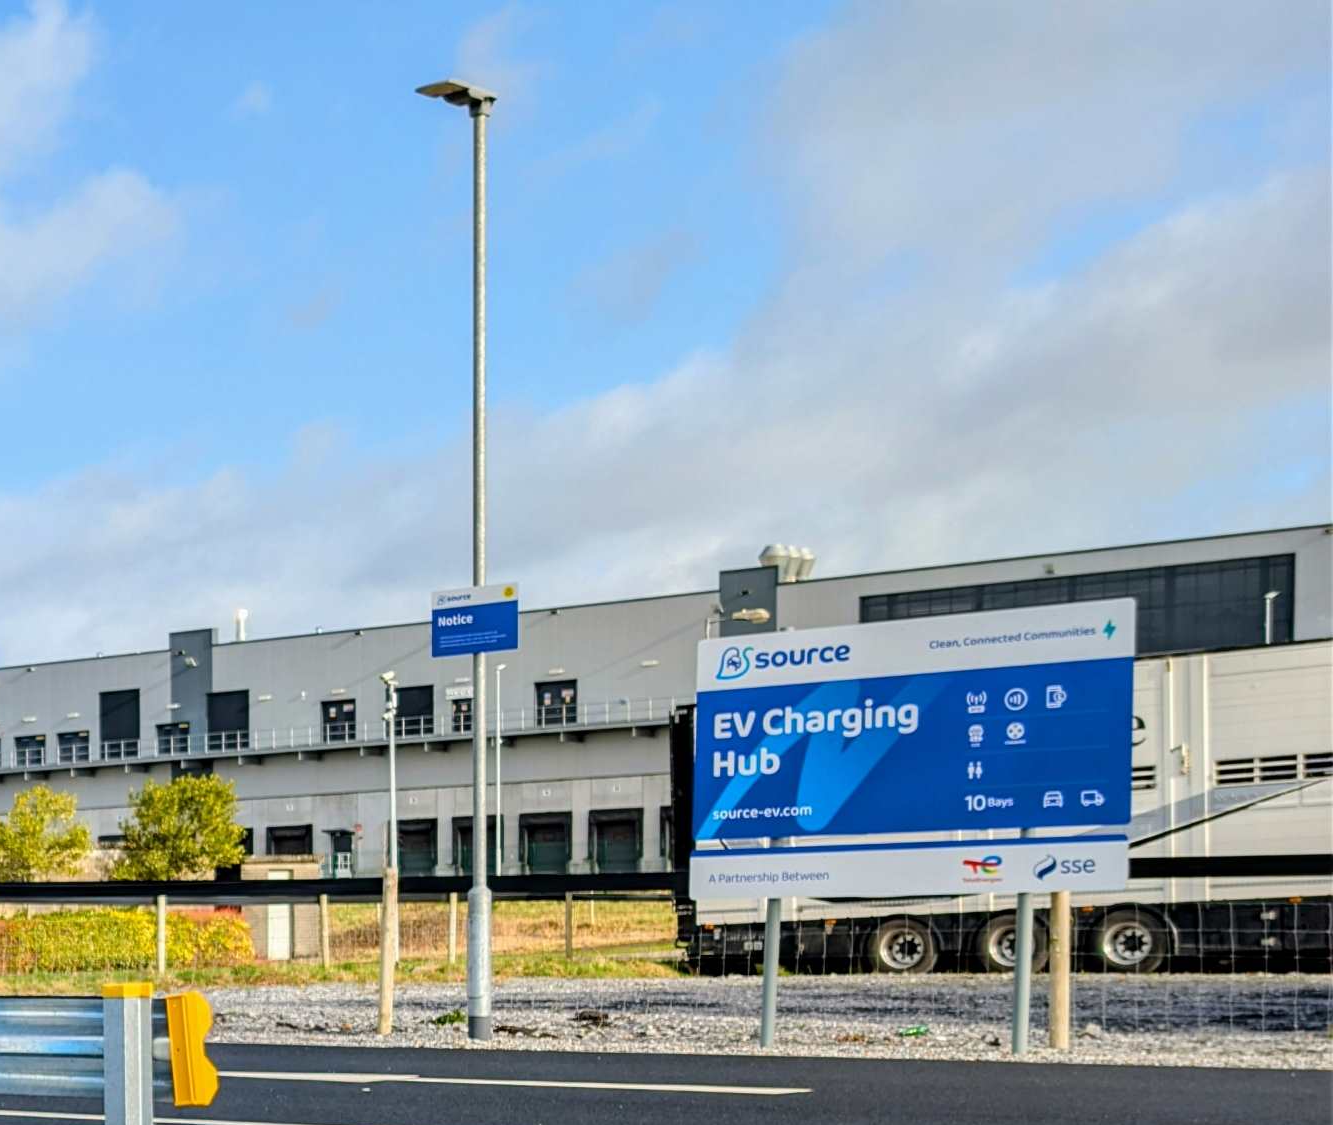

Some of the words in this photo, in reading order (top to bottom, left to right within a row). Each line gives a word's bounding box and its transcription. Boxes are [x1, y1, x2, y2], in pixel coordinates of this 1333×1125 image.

[438, 614, 473, 627] Notice
[929, 639, 961, 650] Clean,
[963, 632, 1022, 647] Connected
[1024, 627, 1096, 641] Communities
[755, 645, 850, 669] source
[714, 710, 756, 739] EV
[762, 698, 919, 738] Charging
[713, 747, 781, 778] Hub
[965, 794, 986, 811] 10
[988, 797, 1014, 808] Bays
[713, 805, 813, 820] source-ev.com
[1060, 859, 1096, 874] sse
[708, 874, 716, 883] A
[718, 872, 779, 884] Partnership
[782, 871, 829, 882] Between
